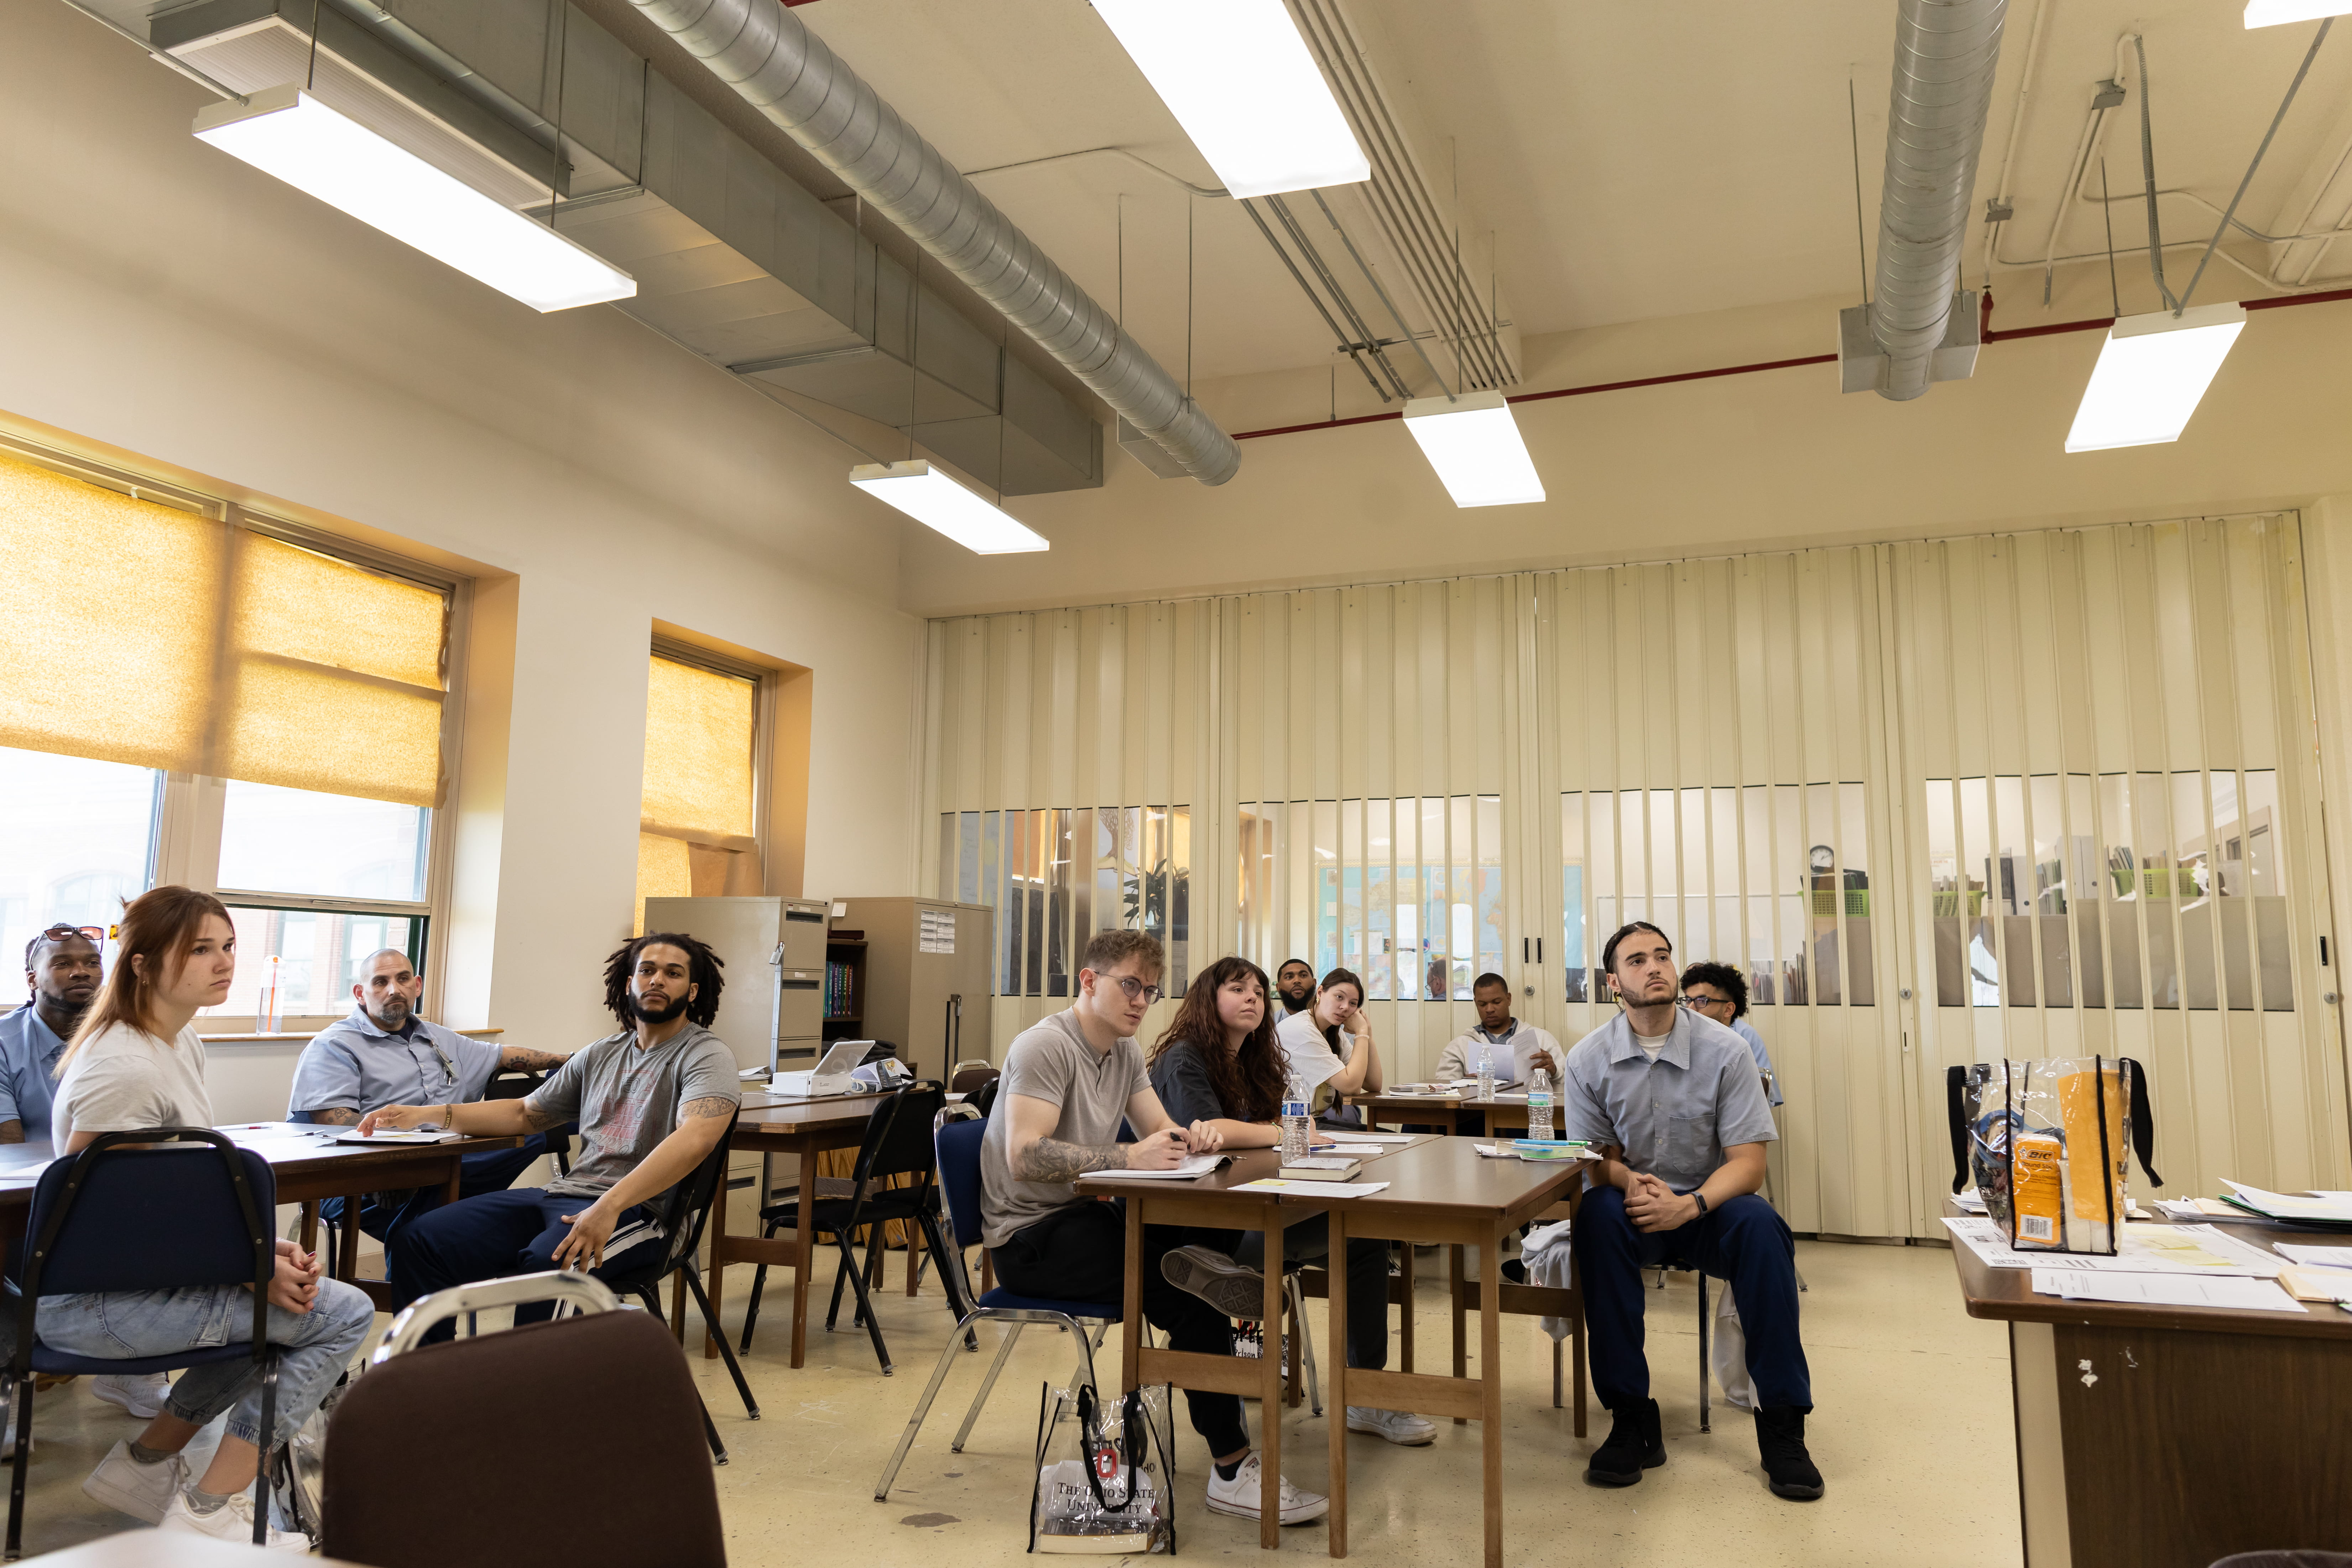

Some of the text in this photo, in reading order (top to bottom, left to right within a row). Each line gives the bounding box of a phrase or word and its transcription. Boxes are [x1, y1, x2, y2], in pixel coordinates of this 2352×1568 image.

[1058, 1482, 1154, 1498] THE OIO SATE
[1067, 1499, 1142, 1514] UNIVRITY
